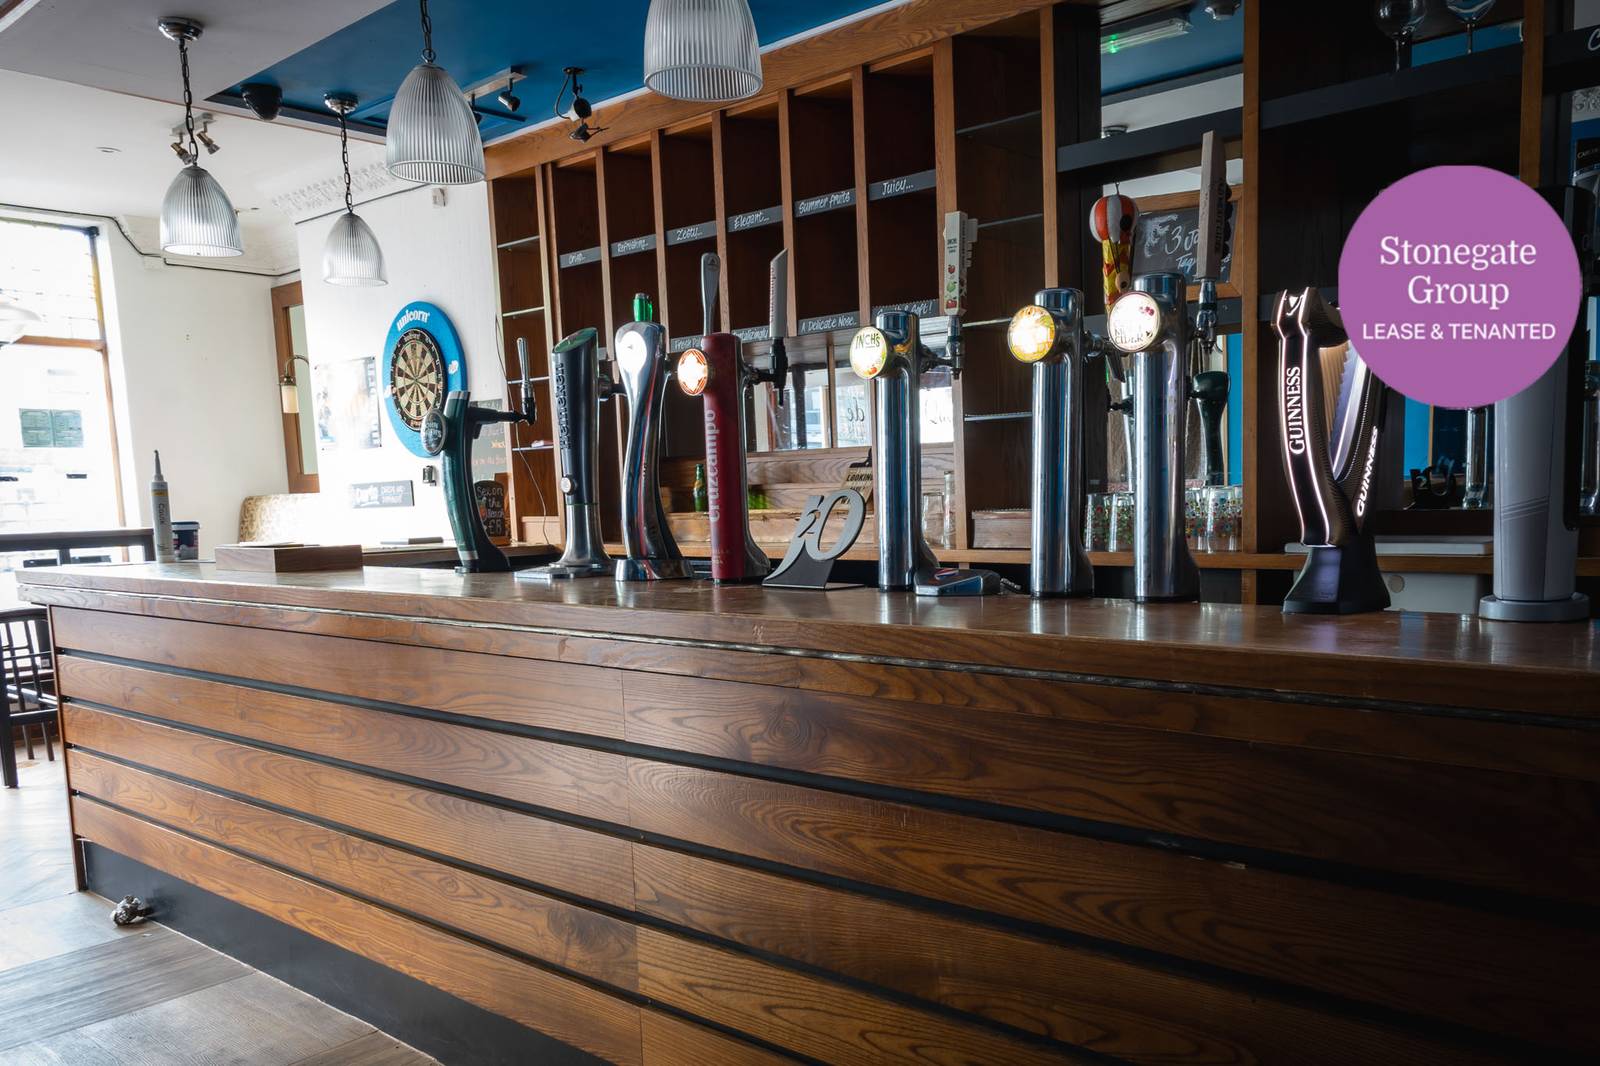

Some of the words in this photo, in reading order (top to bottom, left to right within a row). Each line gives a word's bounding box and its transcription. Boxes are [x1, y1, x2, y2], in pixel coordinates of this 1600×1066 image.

[396, 309, 428, 332] unicorn
[1286, 366, 1305, 455] GUINNESS
[1356, 425, 1379, 517] GUINNESS
